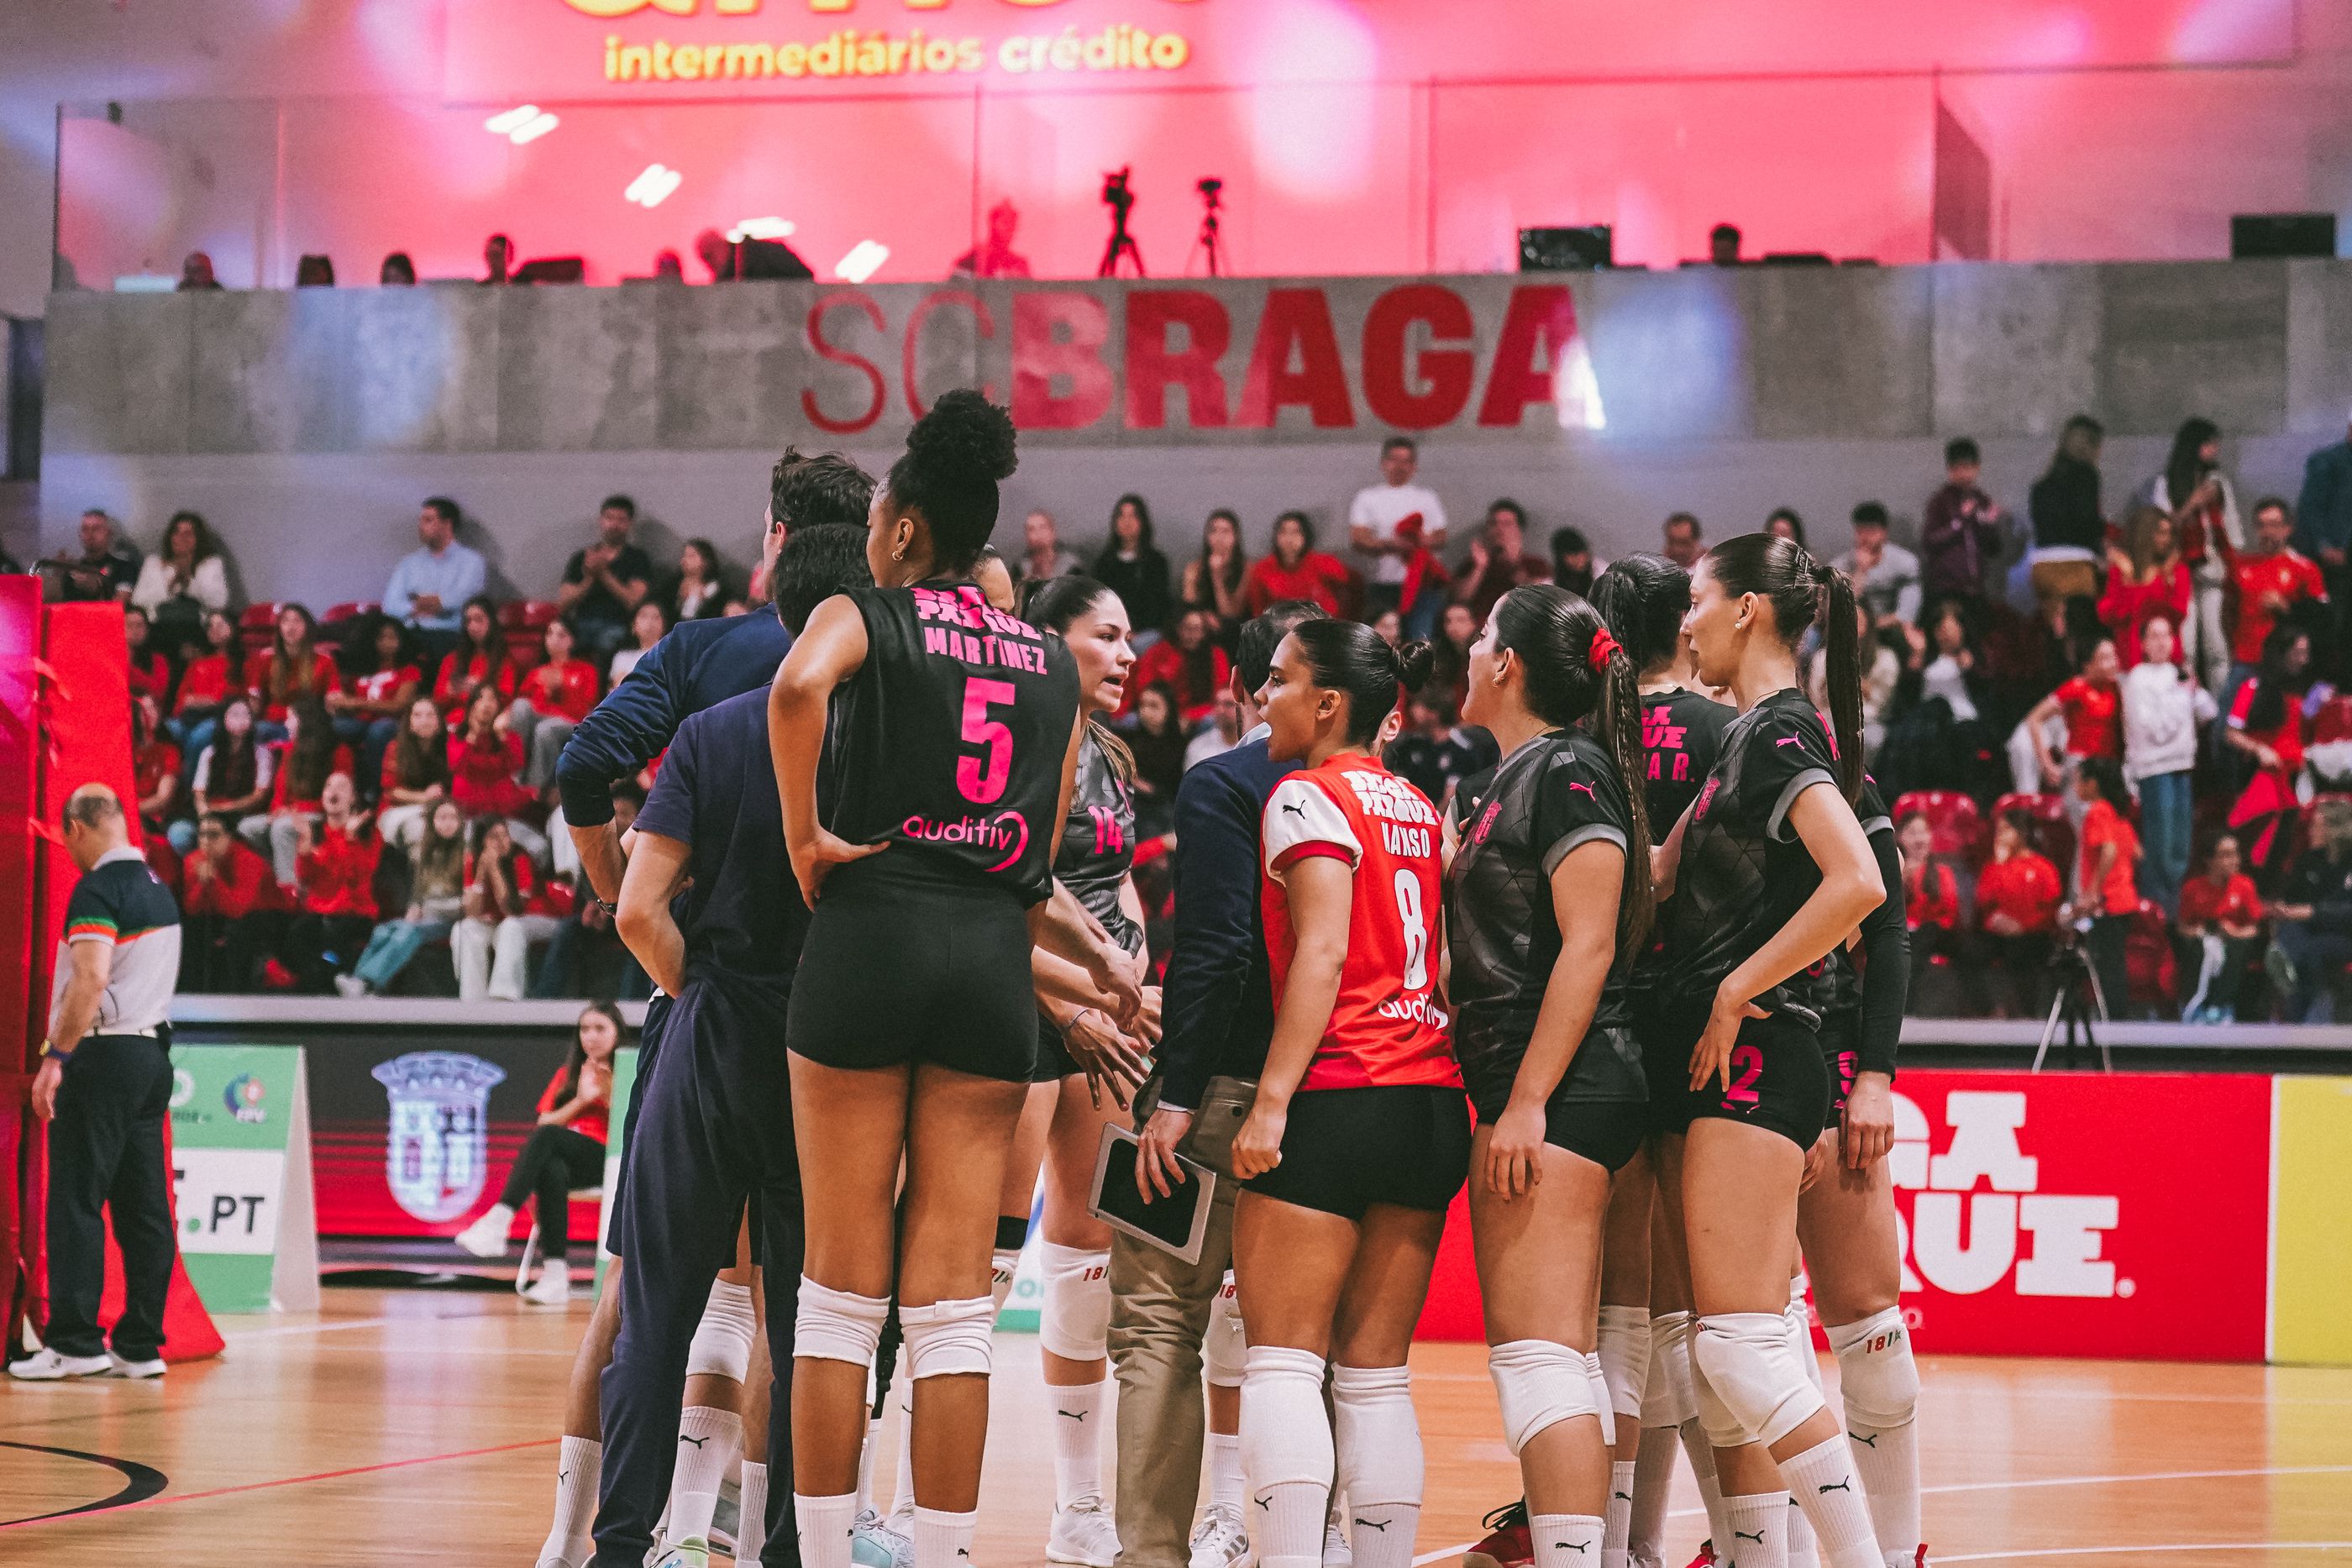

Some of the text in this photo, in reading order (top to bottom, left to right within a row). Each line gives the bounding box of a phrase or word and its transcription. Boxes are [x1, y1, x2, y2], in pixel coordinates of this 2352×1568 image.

[605, 24, 1189, 81] intermediários crédito
[924, 627, 1047, 675] MARTINEZ
[956, 676, 1016, 804] 5
[901, 813, 1016, 853] auditiv
[1088, 805, 1124, 854] 14
[1394, 868, 1428, 990] 8
[1726, 1045, 1763, 1103] 2
